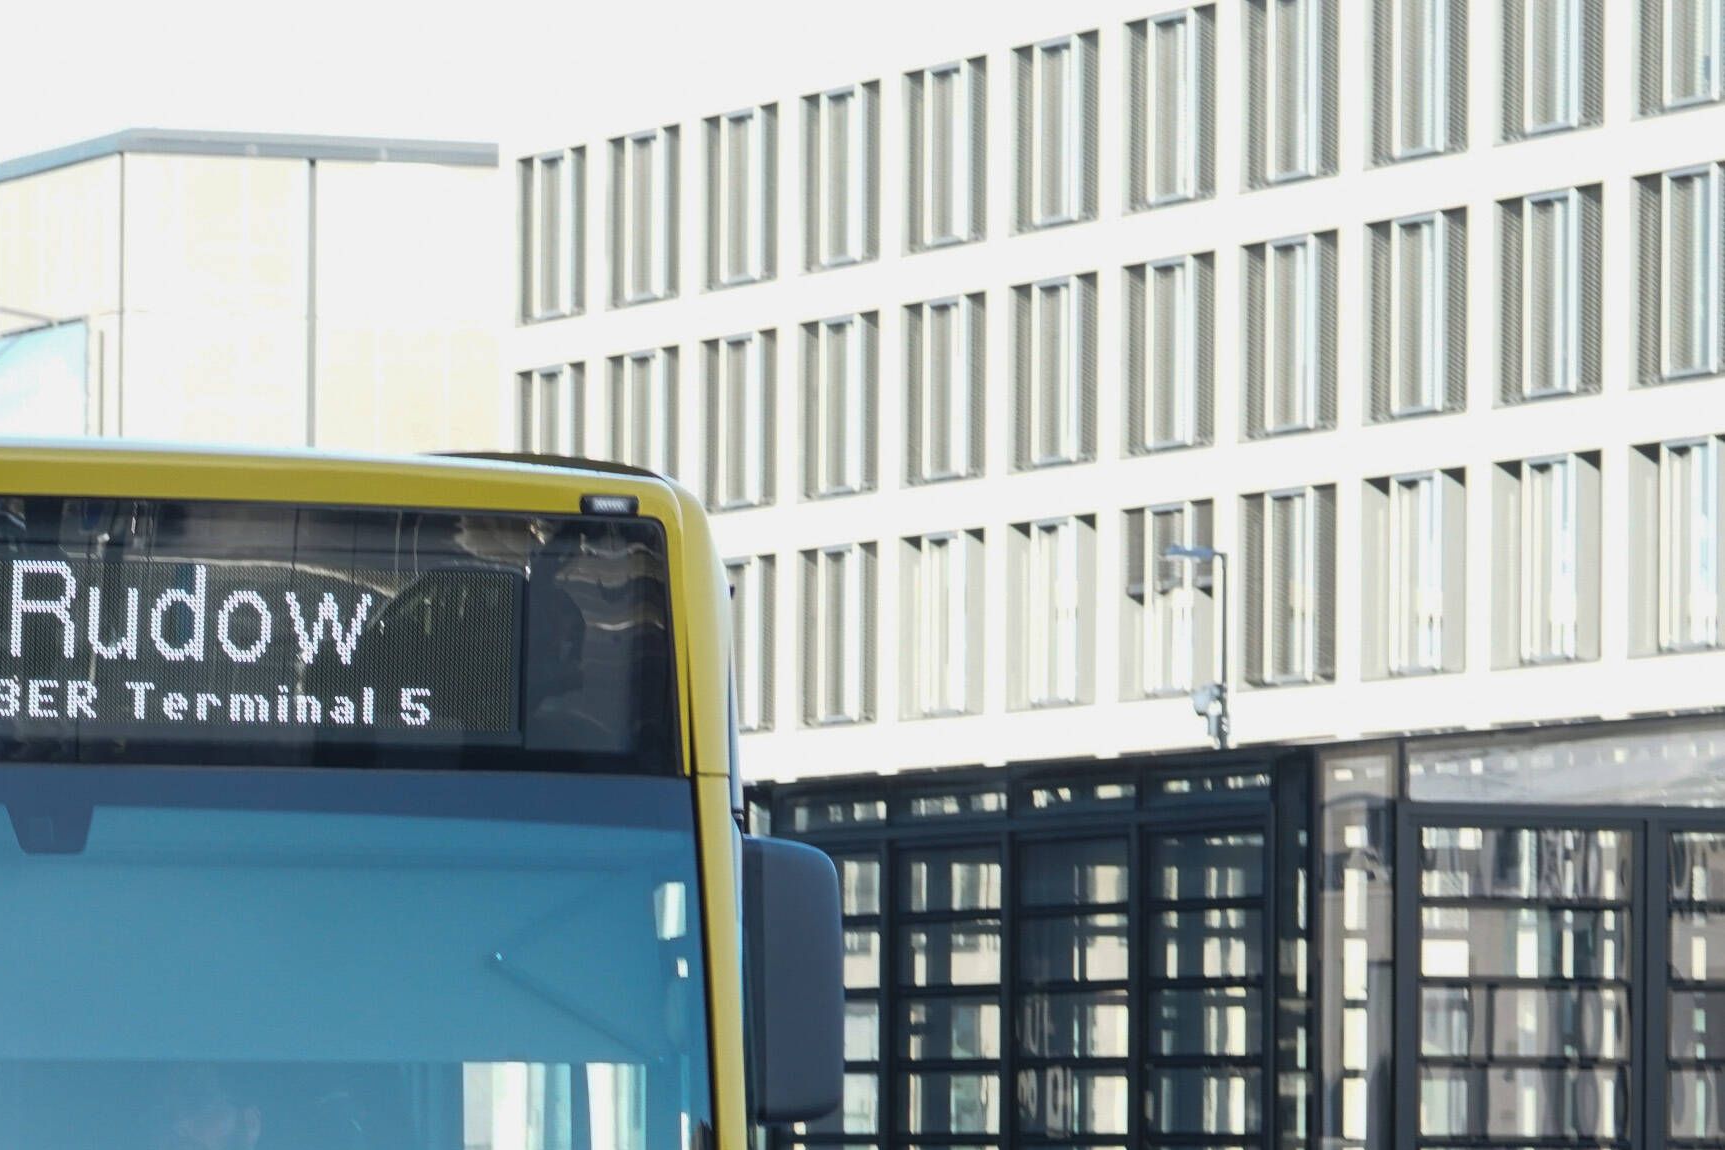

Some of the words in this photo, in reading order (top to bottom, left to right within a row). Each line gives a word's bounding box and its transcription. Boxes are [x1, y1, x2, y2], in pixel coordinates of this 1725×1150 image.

[10, 559, 372, 665] Rudow
[124, 681, 374, 724] Terminal
[399, 688, 432, 725] 5
